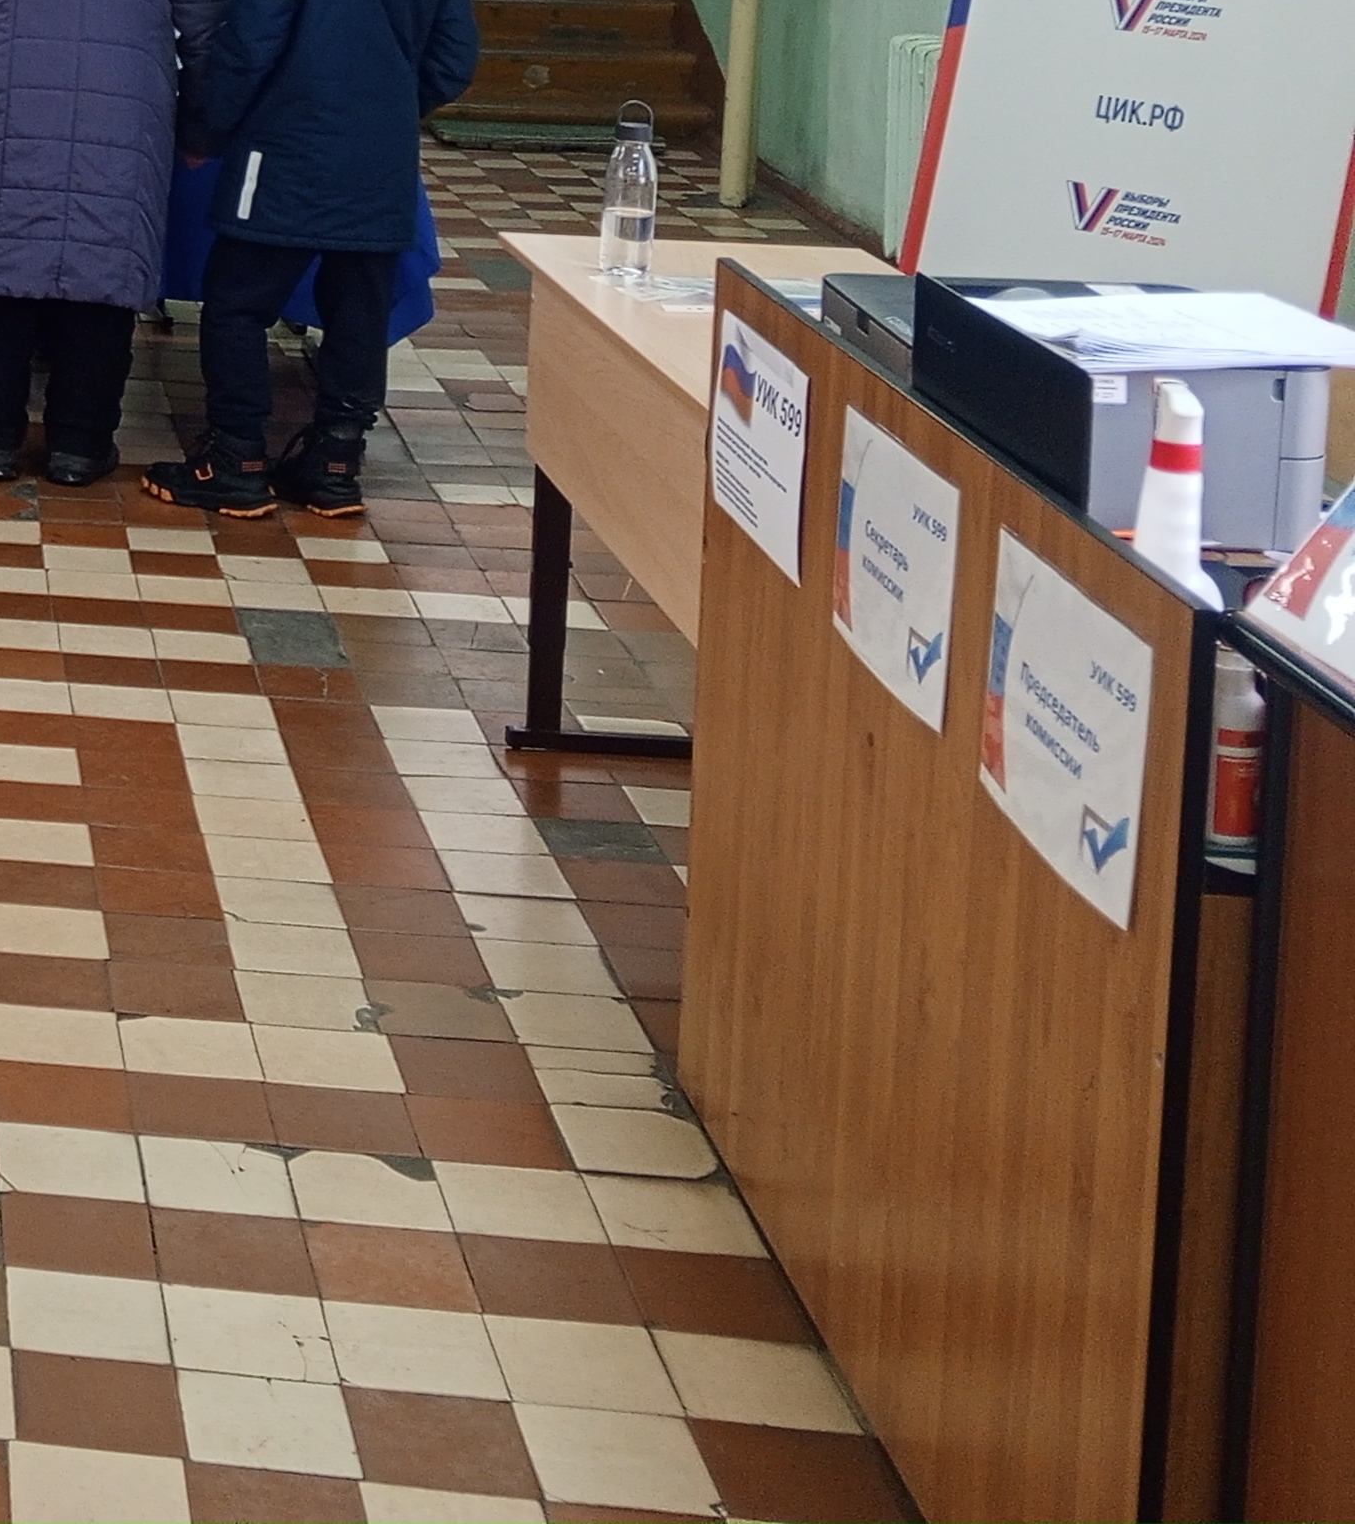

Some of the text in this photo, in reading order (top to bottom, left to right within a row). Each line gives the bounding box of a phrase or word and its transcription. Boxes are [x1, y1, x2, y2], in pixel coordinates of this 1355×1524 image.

[1147, 13, 1192, 27] РОССИИ
[1154, 0, 1223, 18] ПРЕЗИДЕНТА
[1095, 94, 1185, 132] ЦИК.РФ
[1114, 203, 1181, 224] ПРЕЗИДЕНТА
[1122, 191, 1170, 208] ВЫБОРЫ
[1106, 215, 1150, 231] РОССИИ
[755, 373, 802, 437] УИК 599
[912, 503, 948, 542] УИК 599
[865, 519, 909, 572] Секретарь
[862, 554, 903, 603] комиссии
[1089, 660, 1138, 712] УИК 599
[1021, 661, 1101, 753] Председатель
[1025, 712, 1083, 780] комиссии
